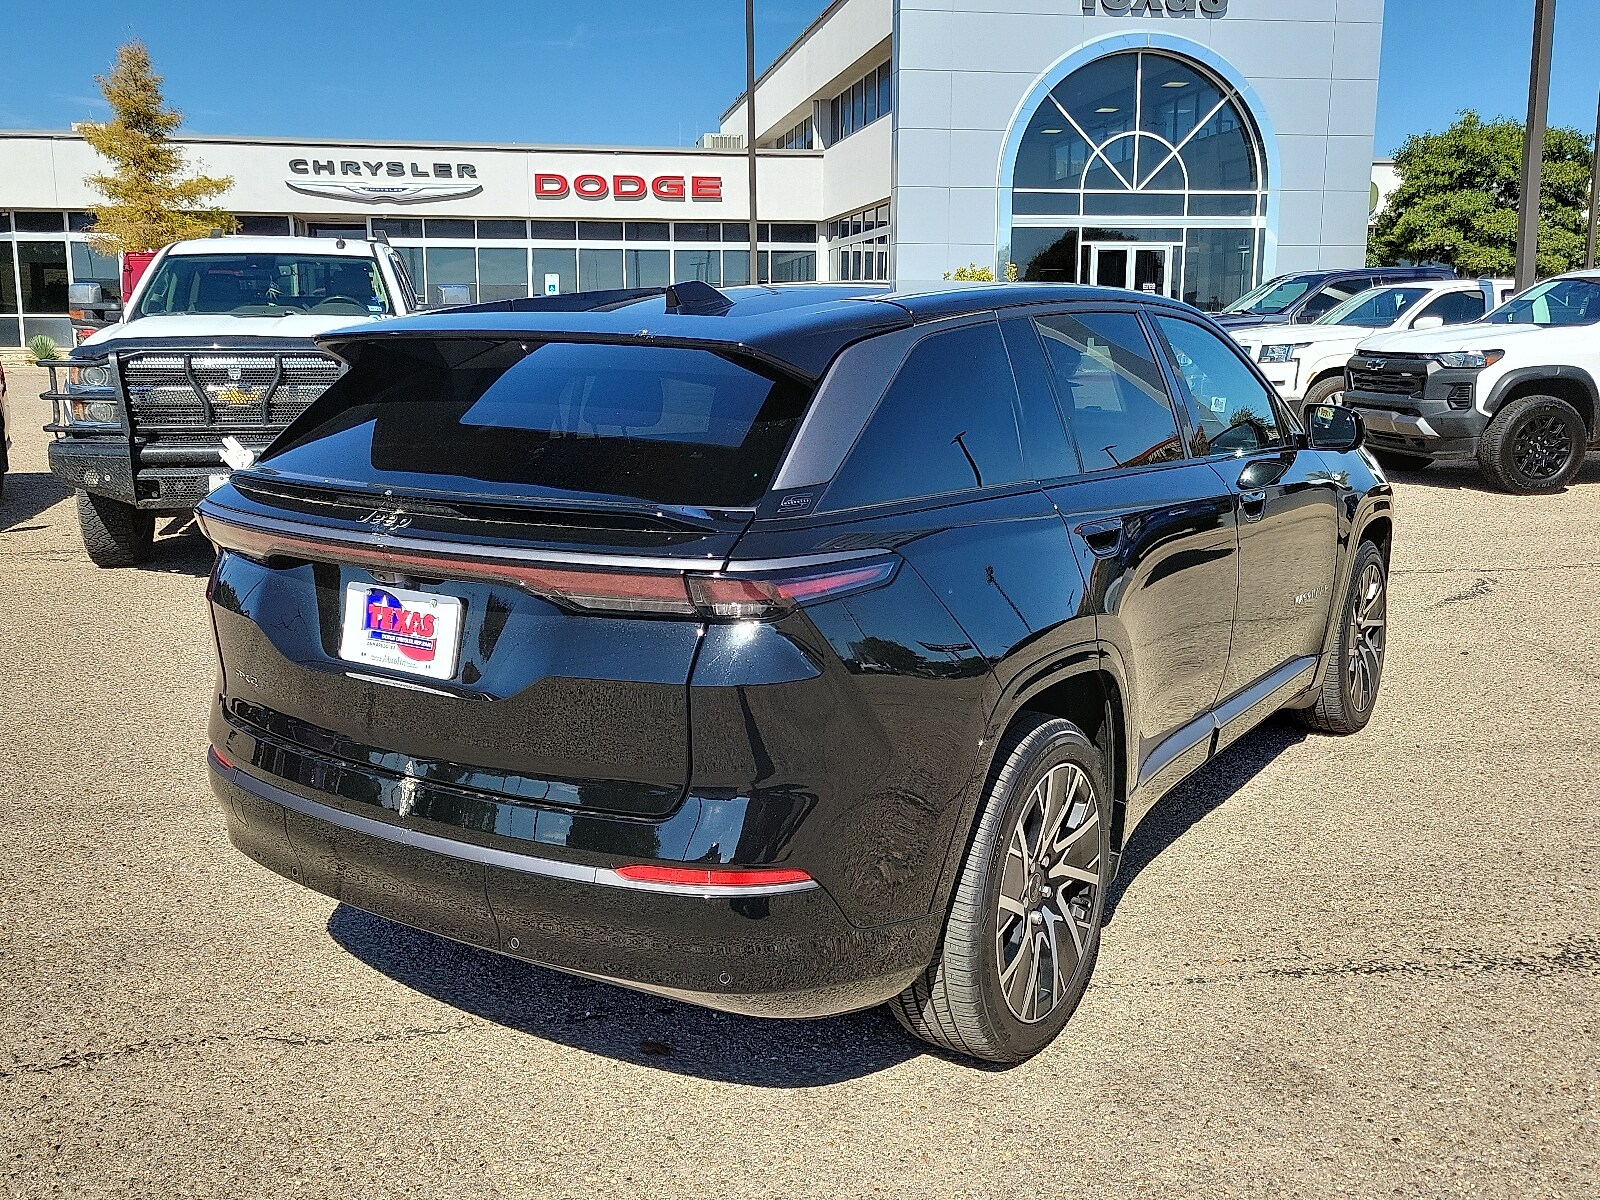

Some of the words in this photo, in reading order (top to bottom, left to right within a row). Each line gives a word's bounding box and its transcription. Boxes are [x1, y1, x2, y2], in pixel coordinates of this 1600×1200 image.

[1081, 0, 1229, 18] exas
[288, 158, 478, 178] CHRYSLER
[534, 173, 723, 202] DODGE
[368, 604, 435, 637] TEXAS
